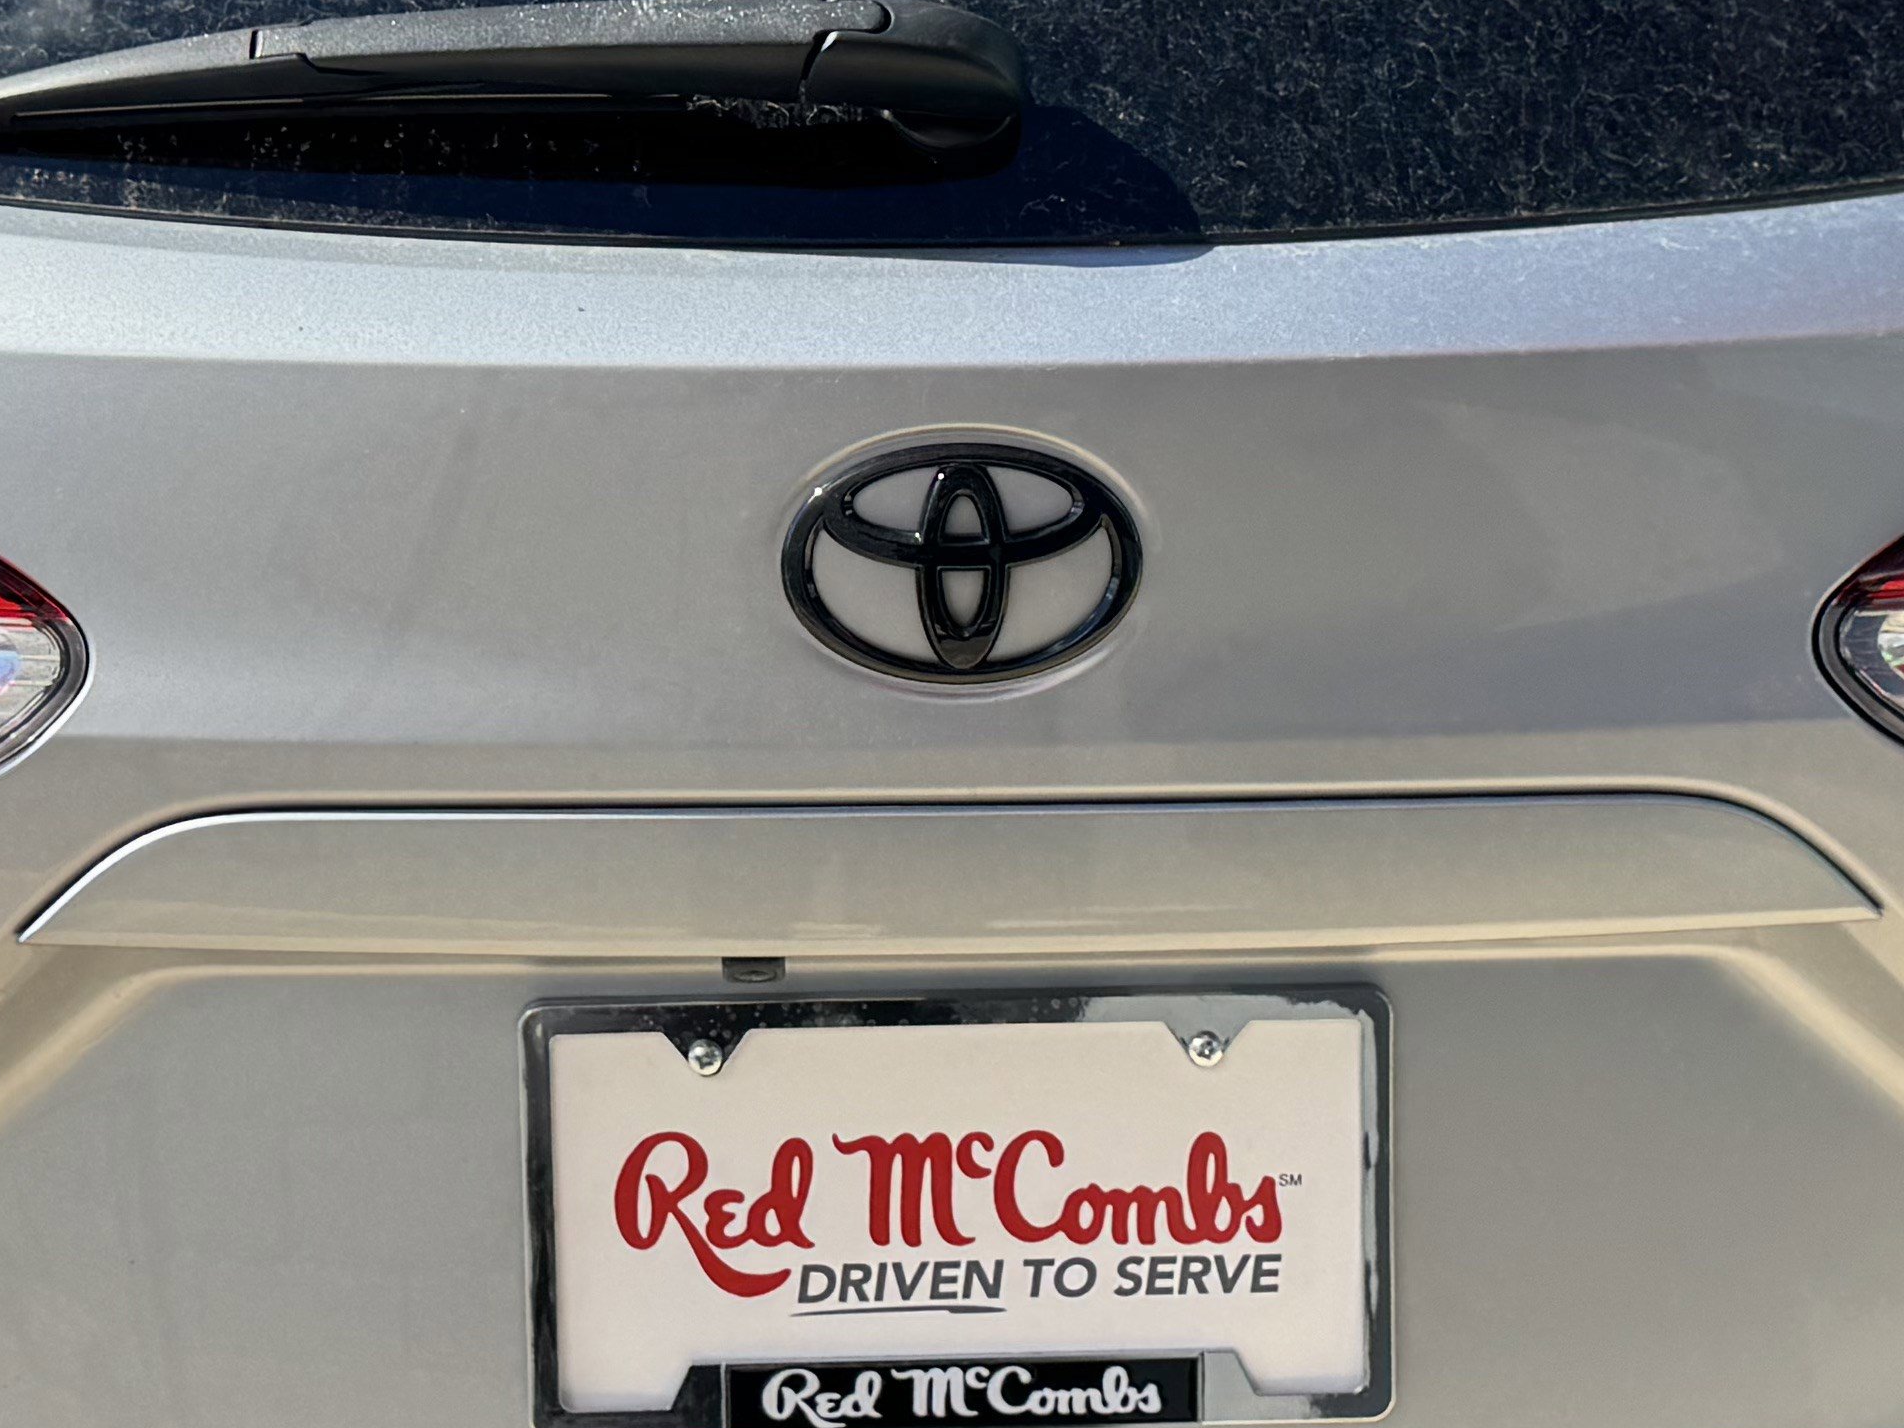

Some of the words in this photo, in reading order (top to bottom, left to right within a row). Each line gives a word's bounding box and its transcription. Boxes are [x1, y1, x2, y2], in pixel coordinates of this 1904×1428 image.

[614, 1131, 815, 1298] Red
[832, 1130, 1283, 1247] McCombs
[796, 1259, 1005, 1304] DRIVEN
[1027, 1257, 1098, 1299] TO
[1114, 1254, 1282, 1298] SERVE
[891, 1365, 1162, 1419] McCombs
